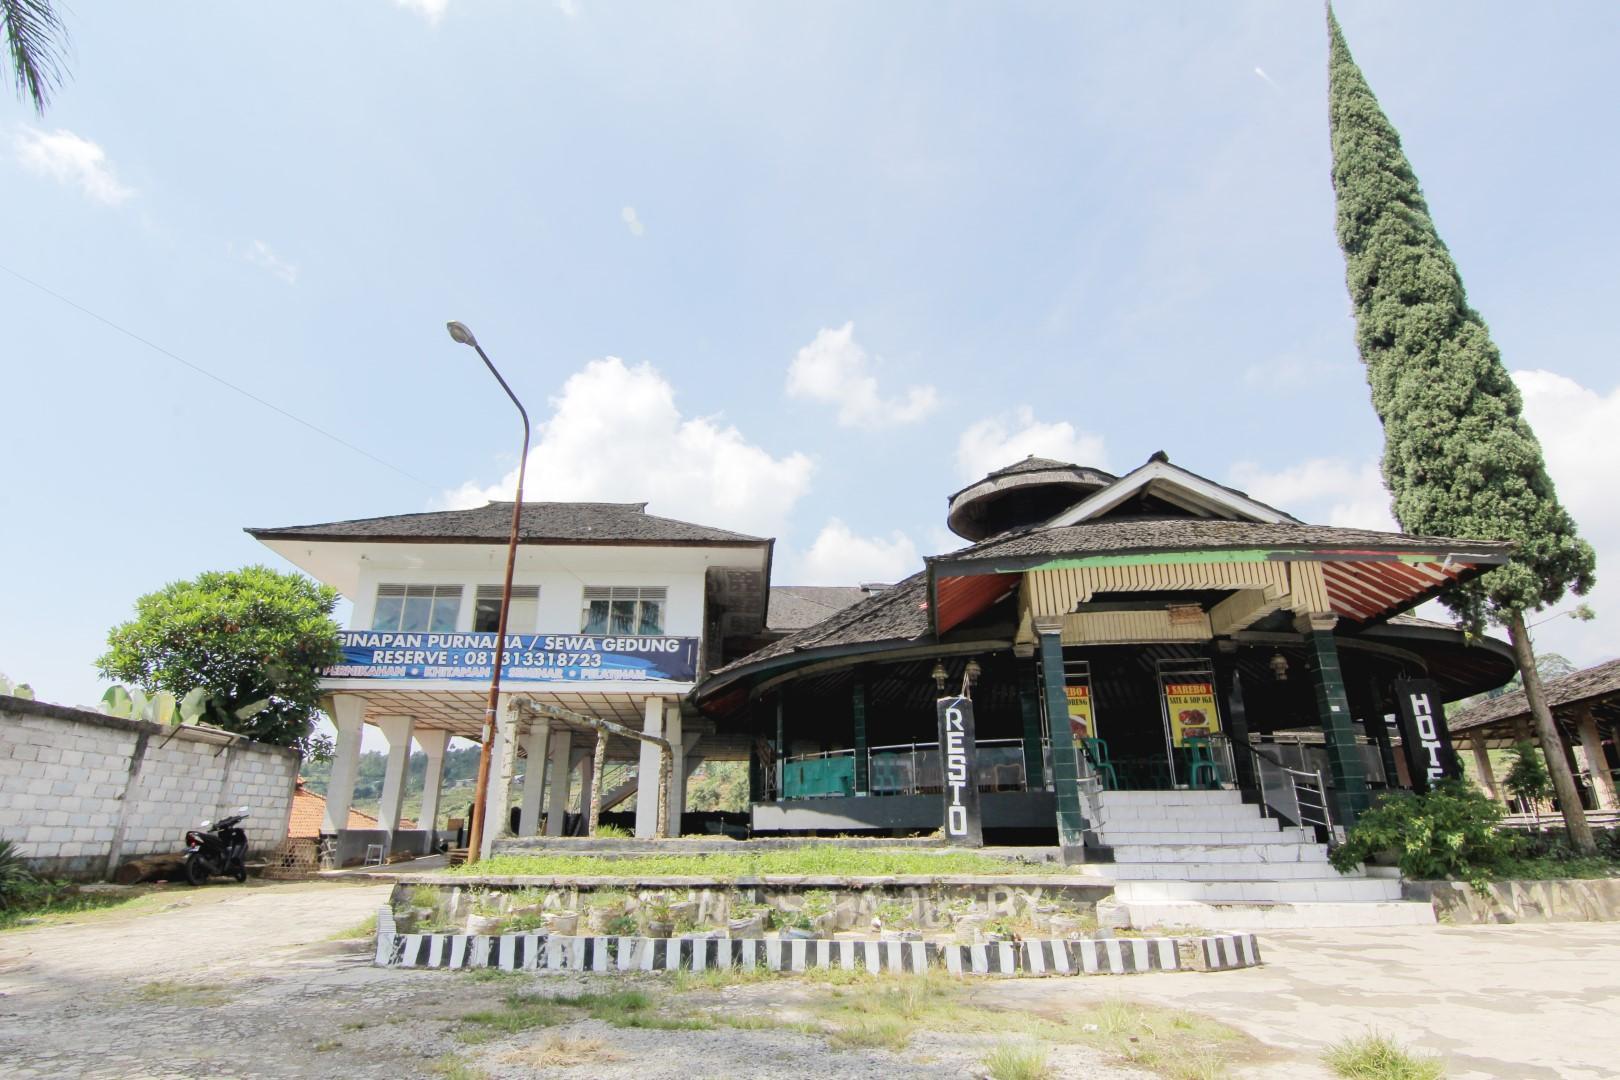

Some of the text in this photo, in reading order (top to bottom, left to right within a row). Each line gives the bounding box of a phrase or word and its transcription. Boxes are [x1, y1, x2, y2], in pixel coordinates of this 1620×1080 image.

[427, 634, 523, 649] PURNAMA
[545, 636, 596, 651] SEWA
[602, 638, 680, 652] GEDUNG
[372, 650, 447, 665] RESERVE
[464, 651, 602, 667] 081313318723
[1172, 684, 1207, 695] SAREBO
[1189, 696, 1201, 704] SOP
[945, 708, 968, 836] RESTO
